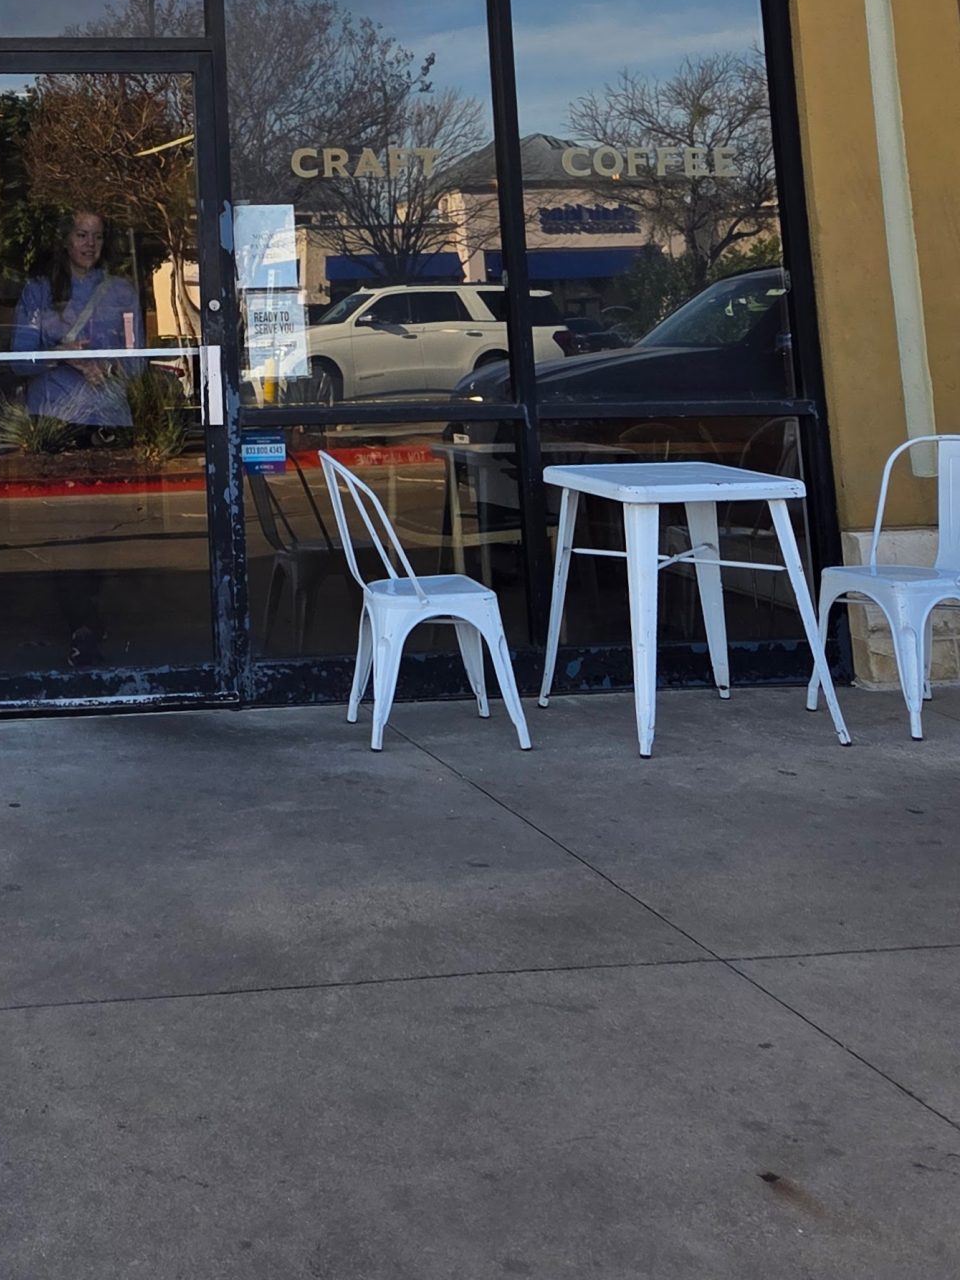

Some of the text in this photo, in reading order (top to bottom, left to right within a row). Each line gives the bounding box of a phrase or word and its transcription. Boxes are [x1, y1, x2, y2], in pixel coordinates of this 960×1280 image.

[290, 145, 740, 179] CRAFT COFFEE
[253, 311, 290, 323] READY TO
[254, 322, 295, 335] SERVE YOU
